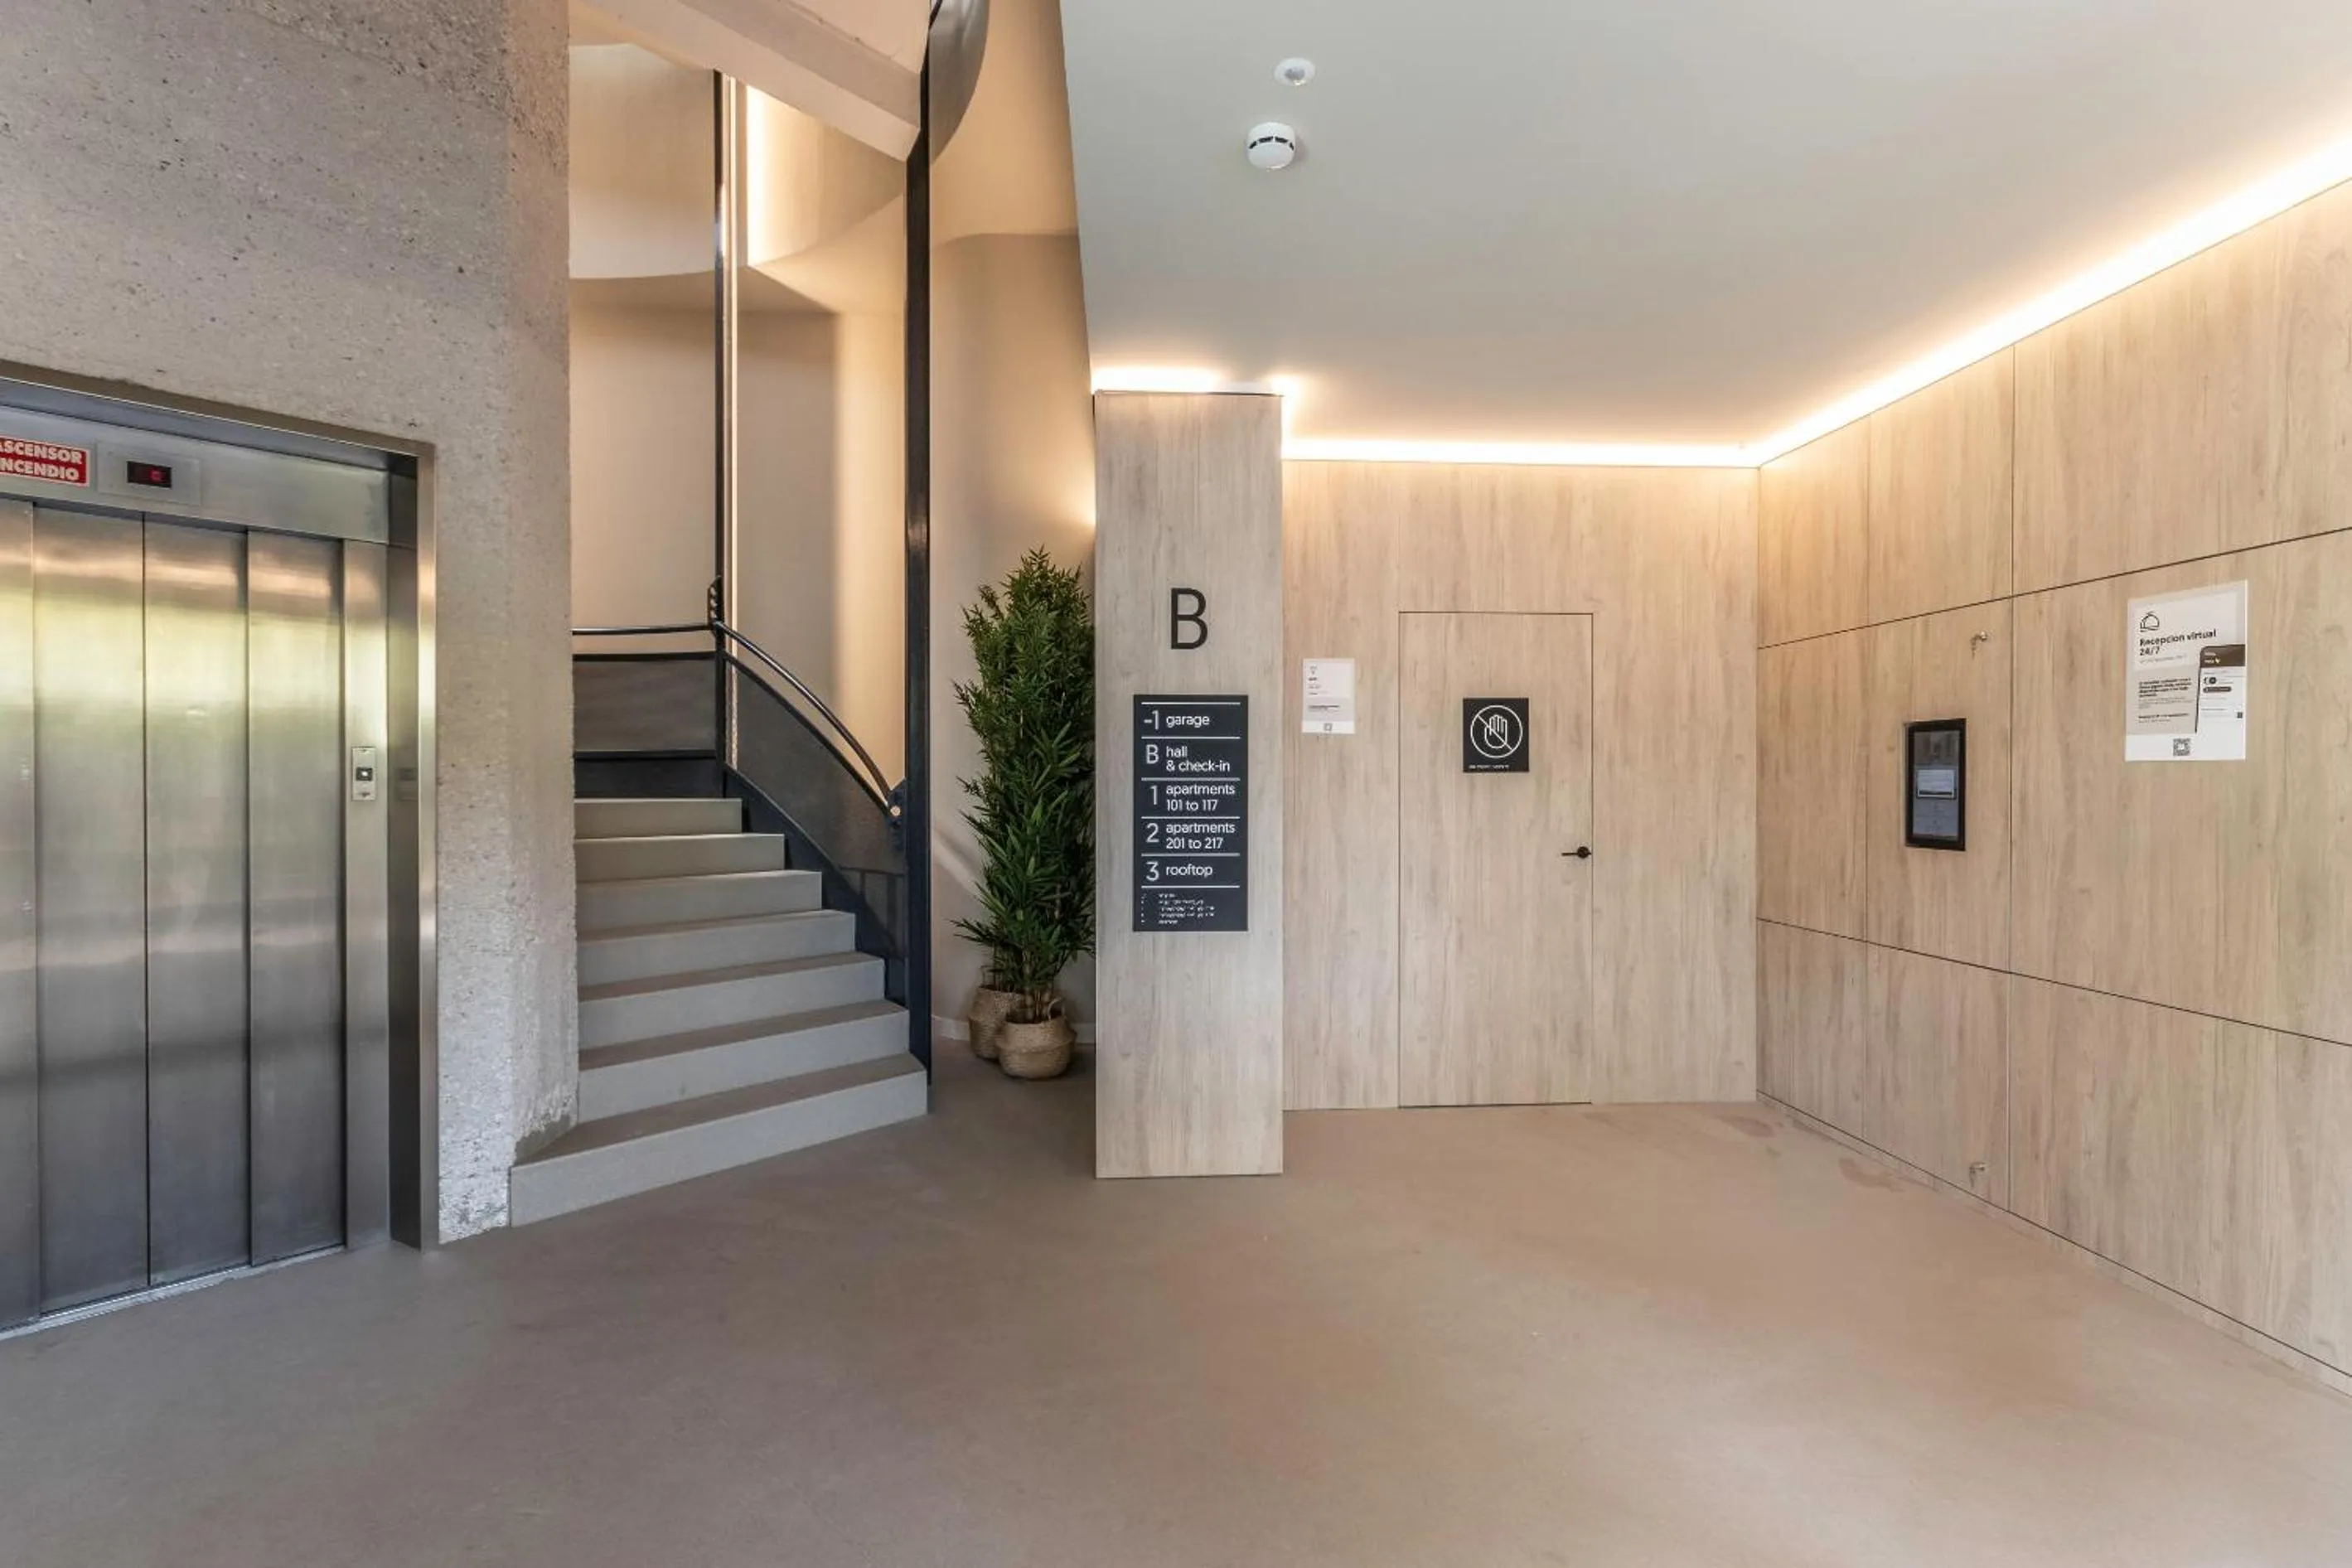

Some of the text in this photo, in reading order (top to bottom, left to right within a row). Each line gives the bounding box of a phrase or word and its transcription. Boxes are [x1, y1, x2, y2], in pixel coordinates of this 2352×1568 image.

[0, 457, 80, 481] NCENDIO
[1171, 588, 1208, 650] B
[1144, 710, 1210, 730] -1 garage
[1146, 744, 1159, 764] B
[1165, 746, 1188, 758] hall
[1166, 760, 1231, 772] & check-in
[1149, 785, 1158, 806] 1
[1166, 784, 1236, 797] apartments
[1166, 799, 1218, 811] 101 to 117
[1146, 823, 1159, 843] 2
[1166, 822, 1236, 836] apartments
[1166, 837, 1224, 849] 201 to 217
[1146, 861, 1159, 882] 3
[1165, 864, 1213, 878] rooftop
